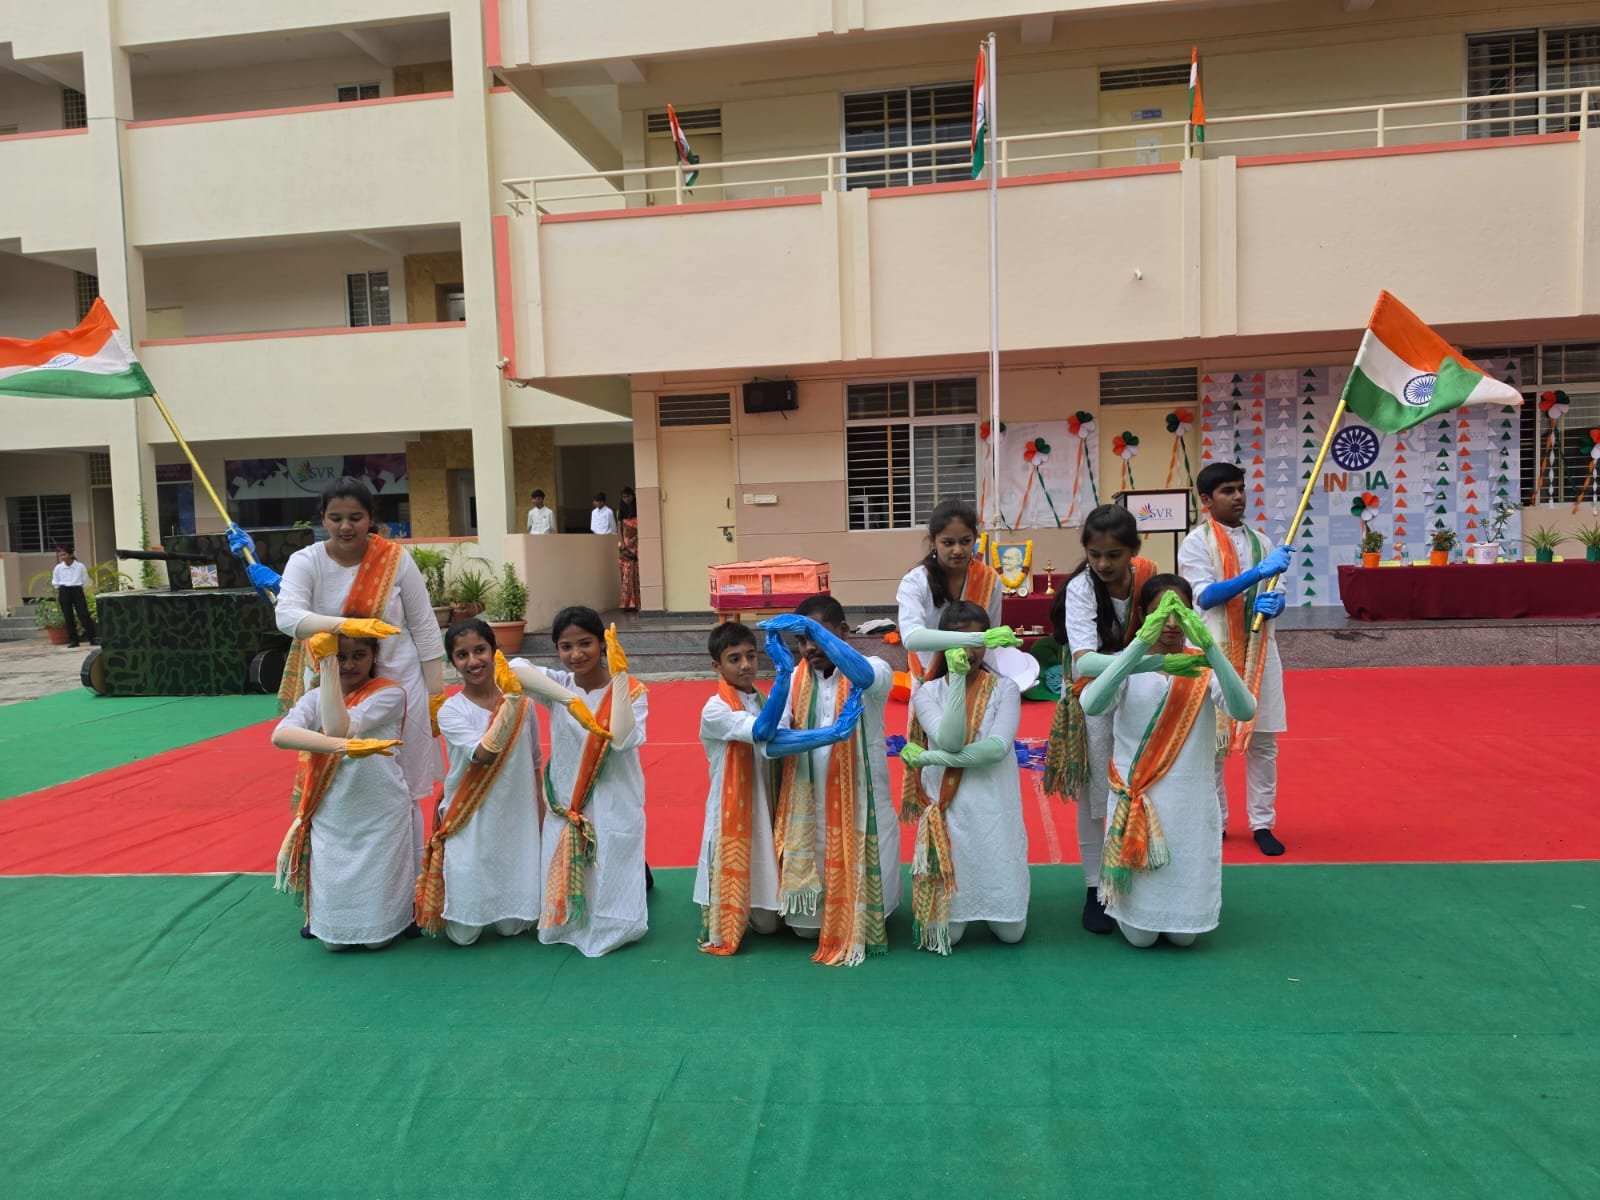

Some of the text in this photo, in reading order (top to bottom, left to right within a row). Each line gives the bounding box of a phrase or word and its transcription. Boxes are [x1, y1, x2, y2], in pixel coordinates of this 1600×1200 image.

[308, 466, 336, 480] SVR
[1323, 470, 1389, 493] INDIA
[1150, 508, 1173, 518] SVR
